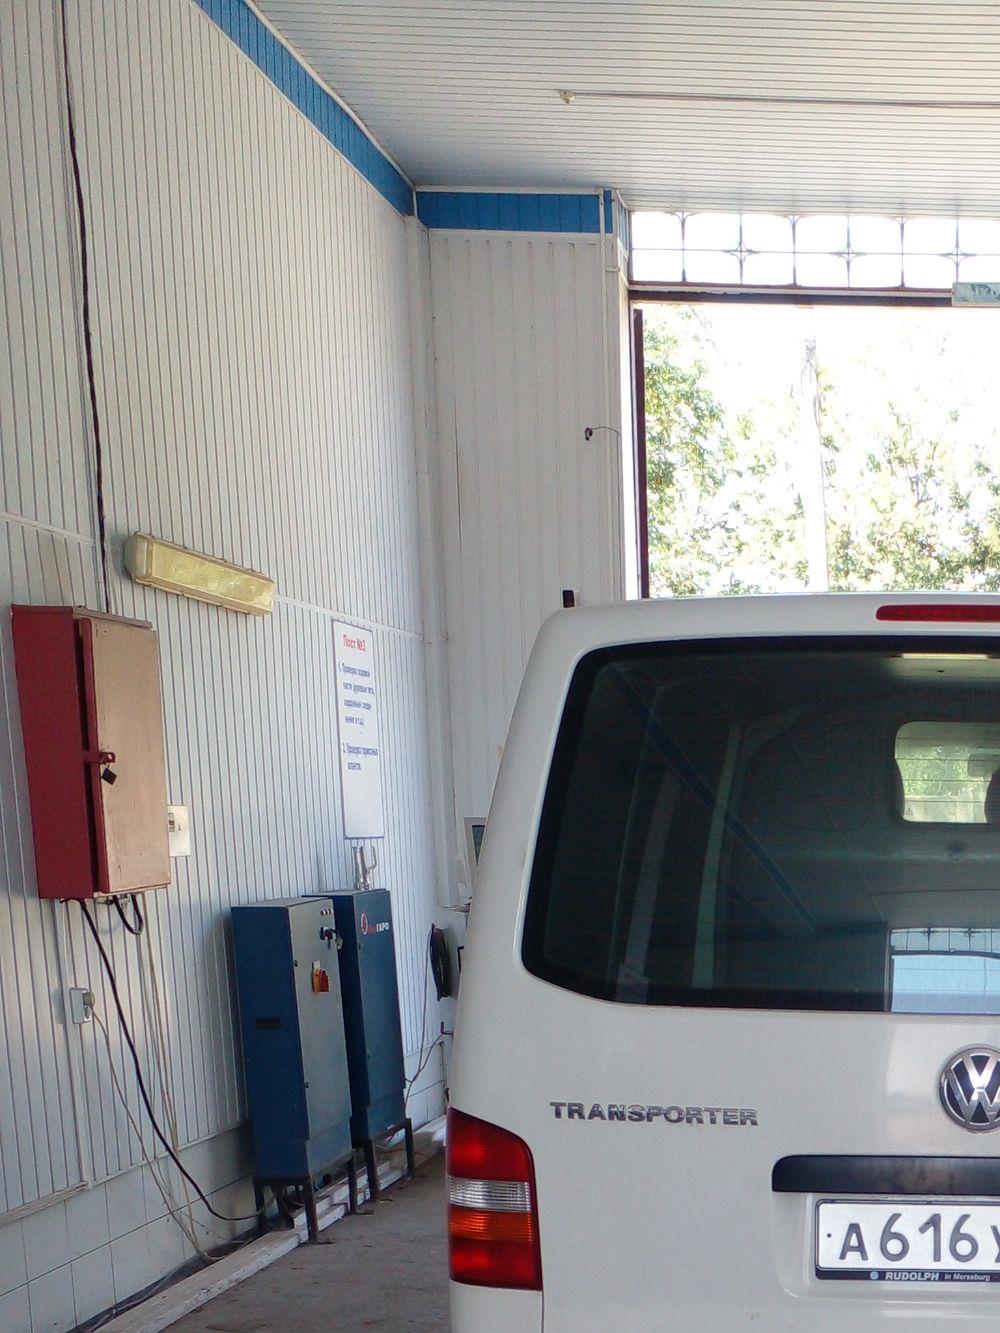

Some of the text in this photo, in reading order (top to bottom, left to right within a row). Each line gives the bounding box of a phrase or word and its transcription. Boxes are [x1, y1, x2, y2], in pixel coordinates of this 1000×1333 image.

[549, 1101, 759, 1126] TRANSPORTER
[885, 1271, 940, 1281] RUDOLPH
[953, 1273, 991, 1282] Merseburg
